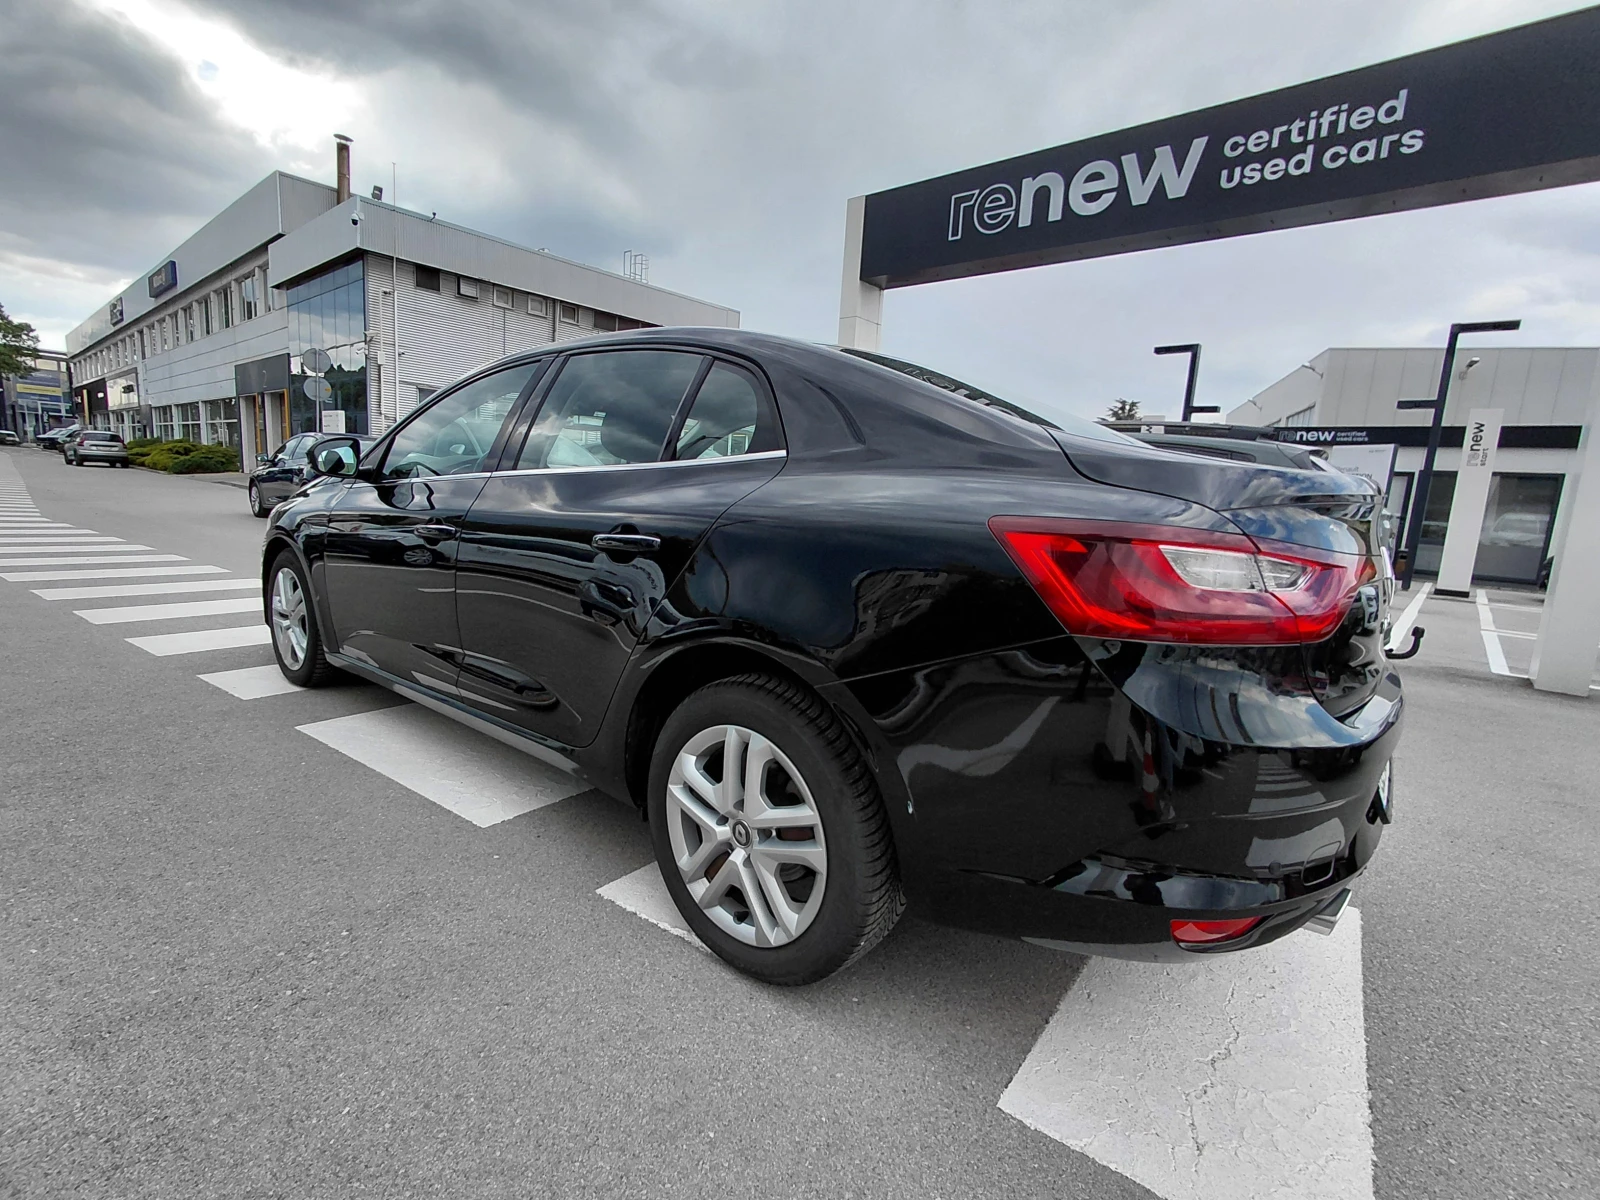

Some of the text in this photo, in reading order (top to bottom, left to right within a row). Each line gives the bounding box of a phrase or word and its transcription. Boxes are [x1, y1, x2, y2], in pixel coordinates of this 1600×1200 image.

[1223, 88, 1409, 158] certified
[947, 135, 1209, 242] renew
[1219, 129, 1425, 189] used cars
[1279, 430, 1336, 442] renew
[1466, 421, 1486, 466] renew
